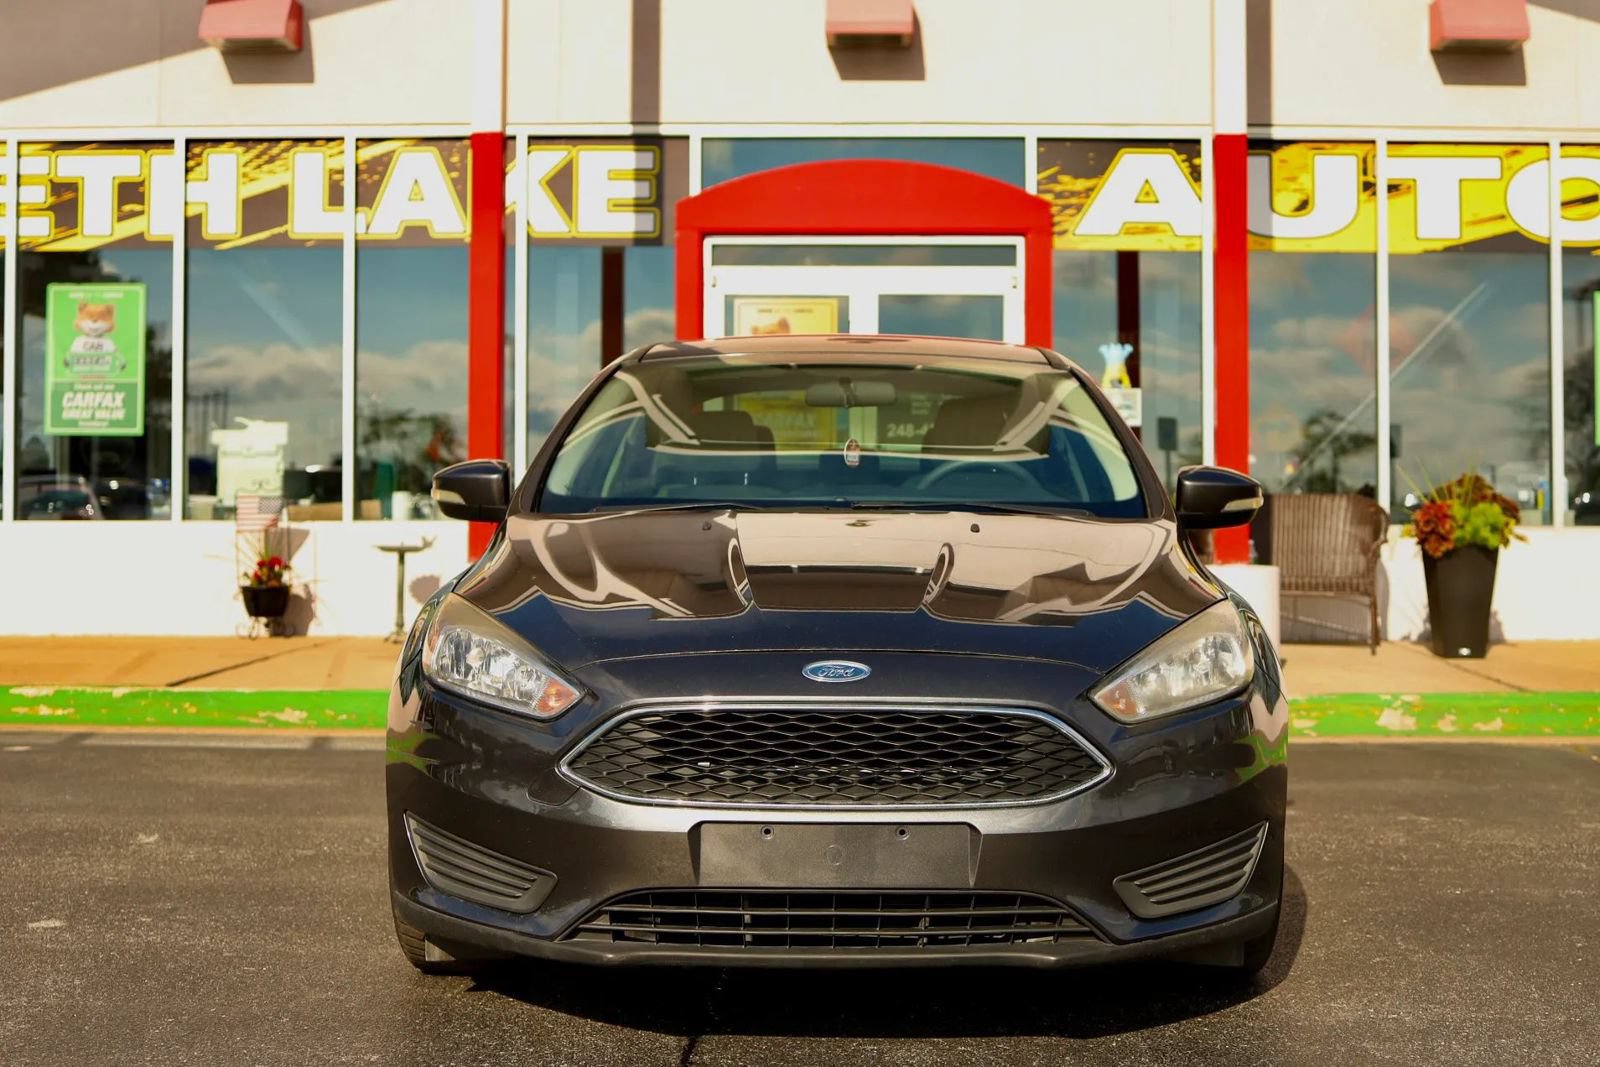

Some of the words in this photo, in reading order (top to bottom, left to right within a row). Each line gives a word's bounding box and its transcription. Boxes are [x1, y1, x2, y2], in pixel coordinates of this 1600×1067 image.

[289, 146, 661, 239] LAKE
[1071, 152, 1600, 243] AUTO
[62, 392, 126, 408] CARFAX
[817, 664, 856, 677] Ford
